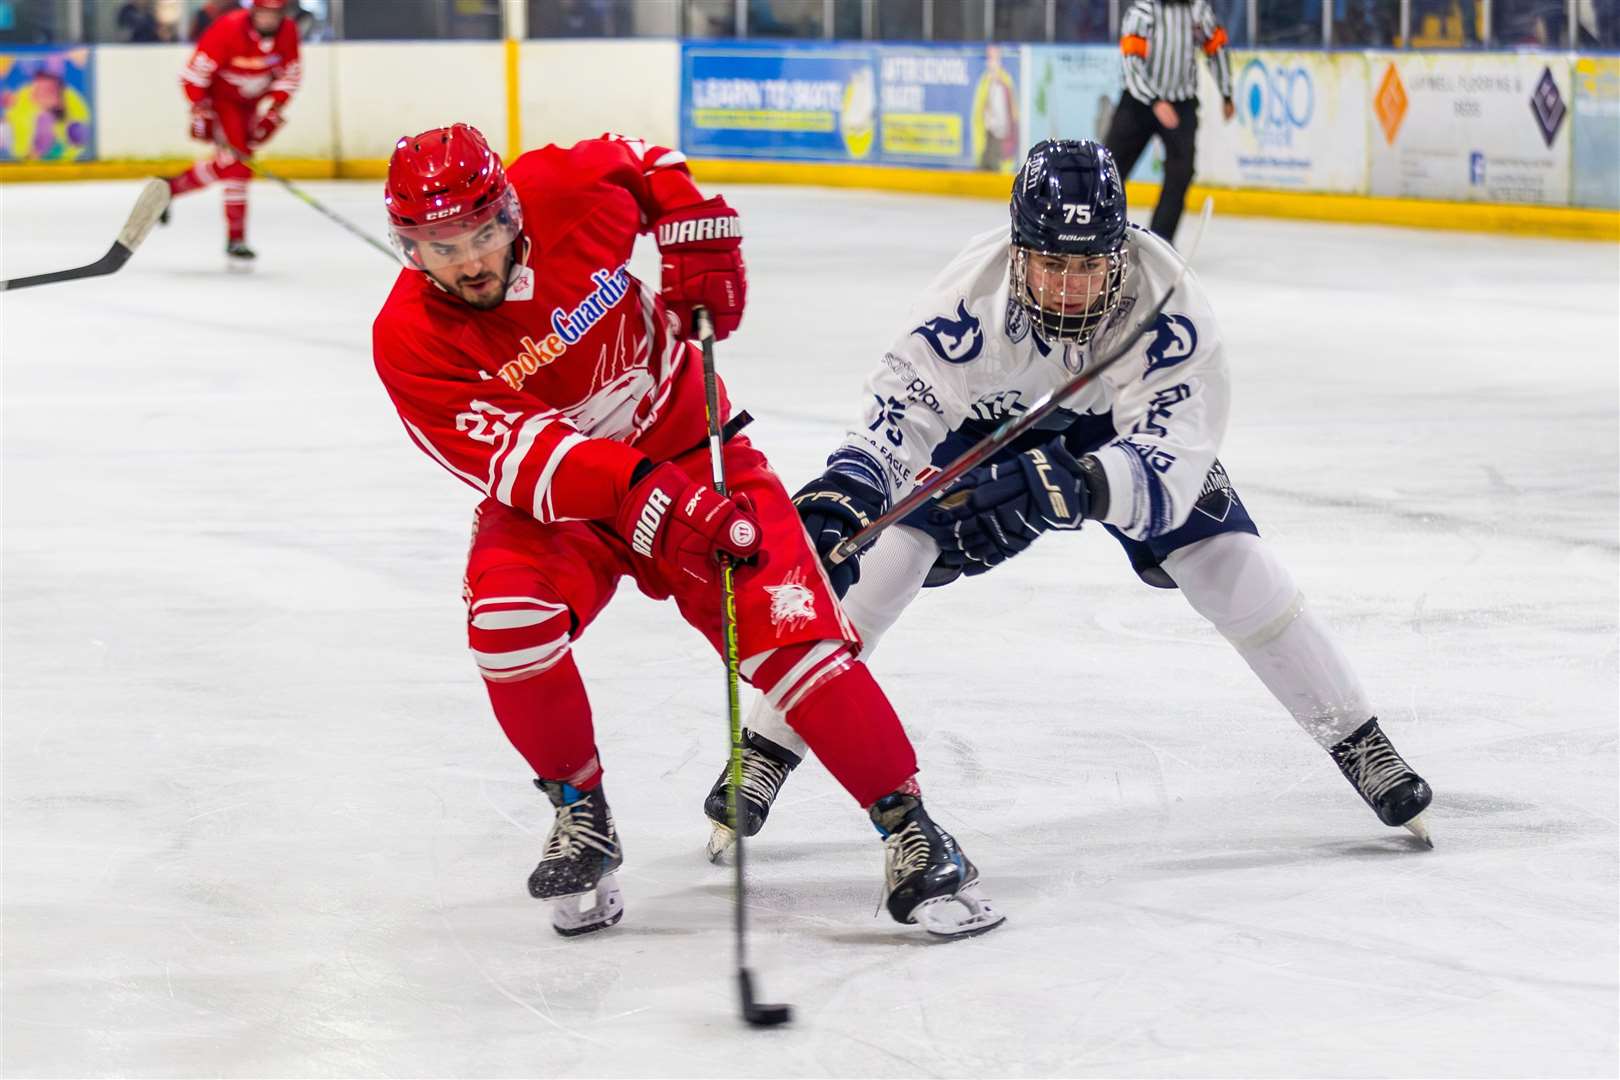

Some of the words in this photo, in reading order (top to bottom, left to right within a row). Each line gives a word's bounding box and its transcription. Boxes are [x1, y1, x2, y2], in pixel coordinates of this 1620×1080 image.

[426, 204, 462, 221] CCM
[1062, 203, 1092, 225] 75
[455, 399, 524, 446] 21
